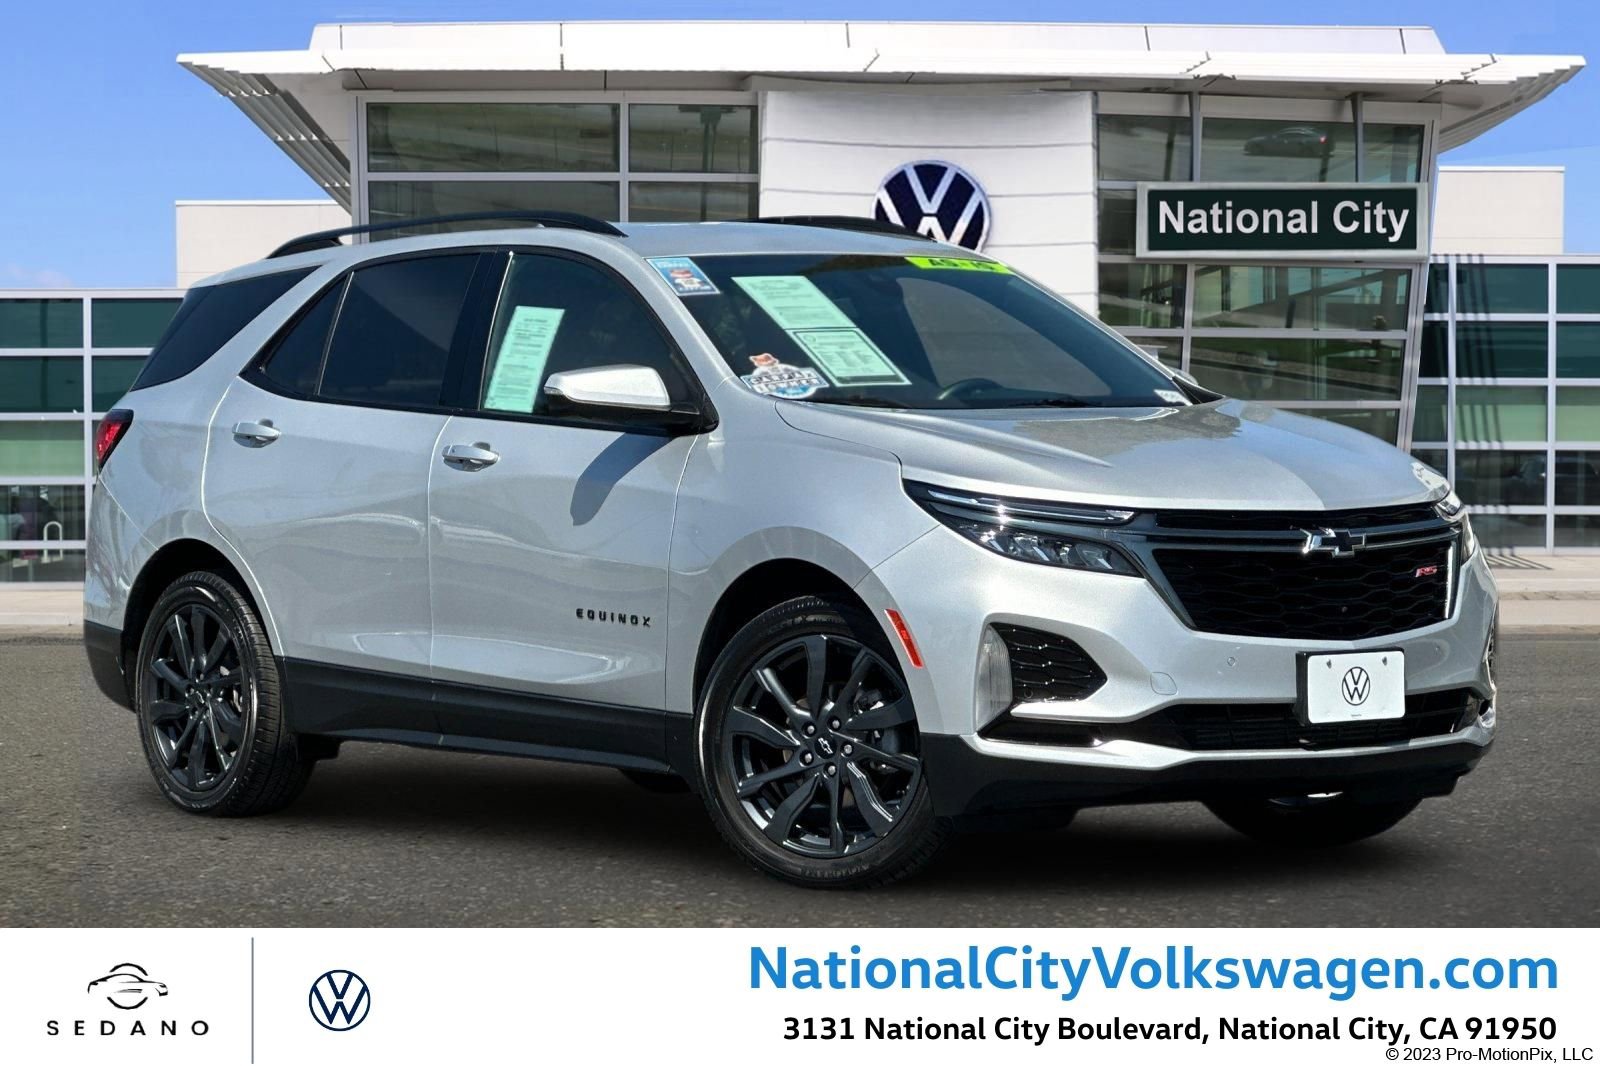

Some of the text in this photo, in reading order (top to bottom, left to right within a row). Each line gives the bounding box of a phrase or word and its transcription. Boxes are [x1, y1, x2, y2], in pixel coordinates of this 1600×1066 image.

[1158, 200, 1410, 242] National City
[576, 608, 651, 628] EQUINOX
